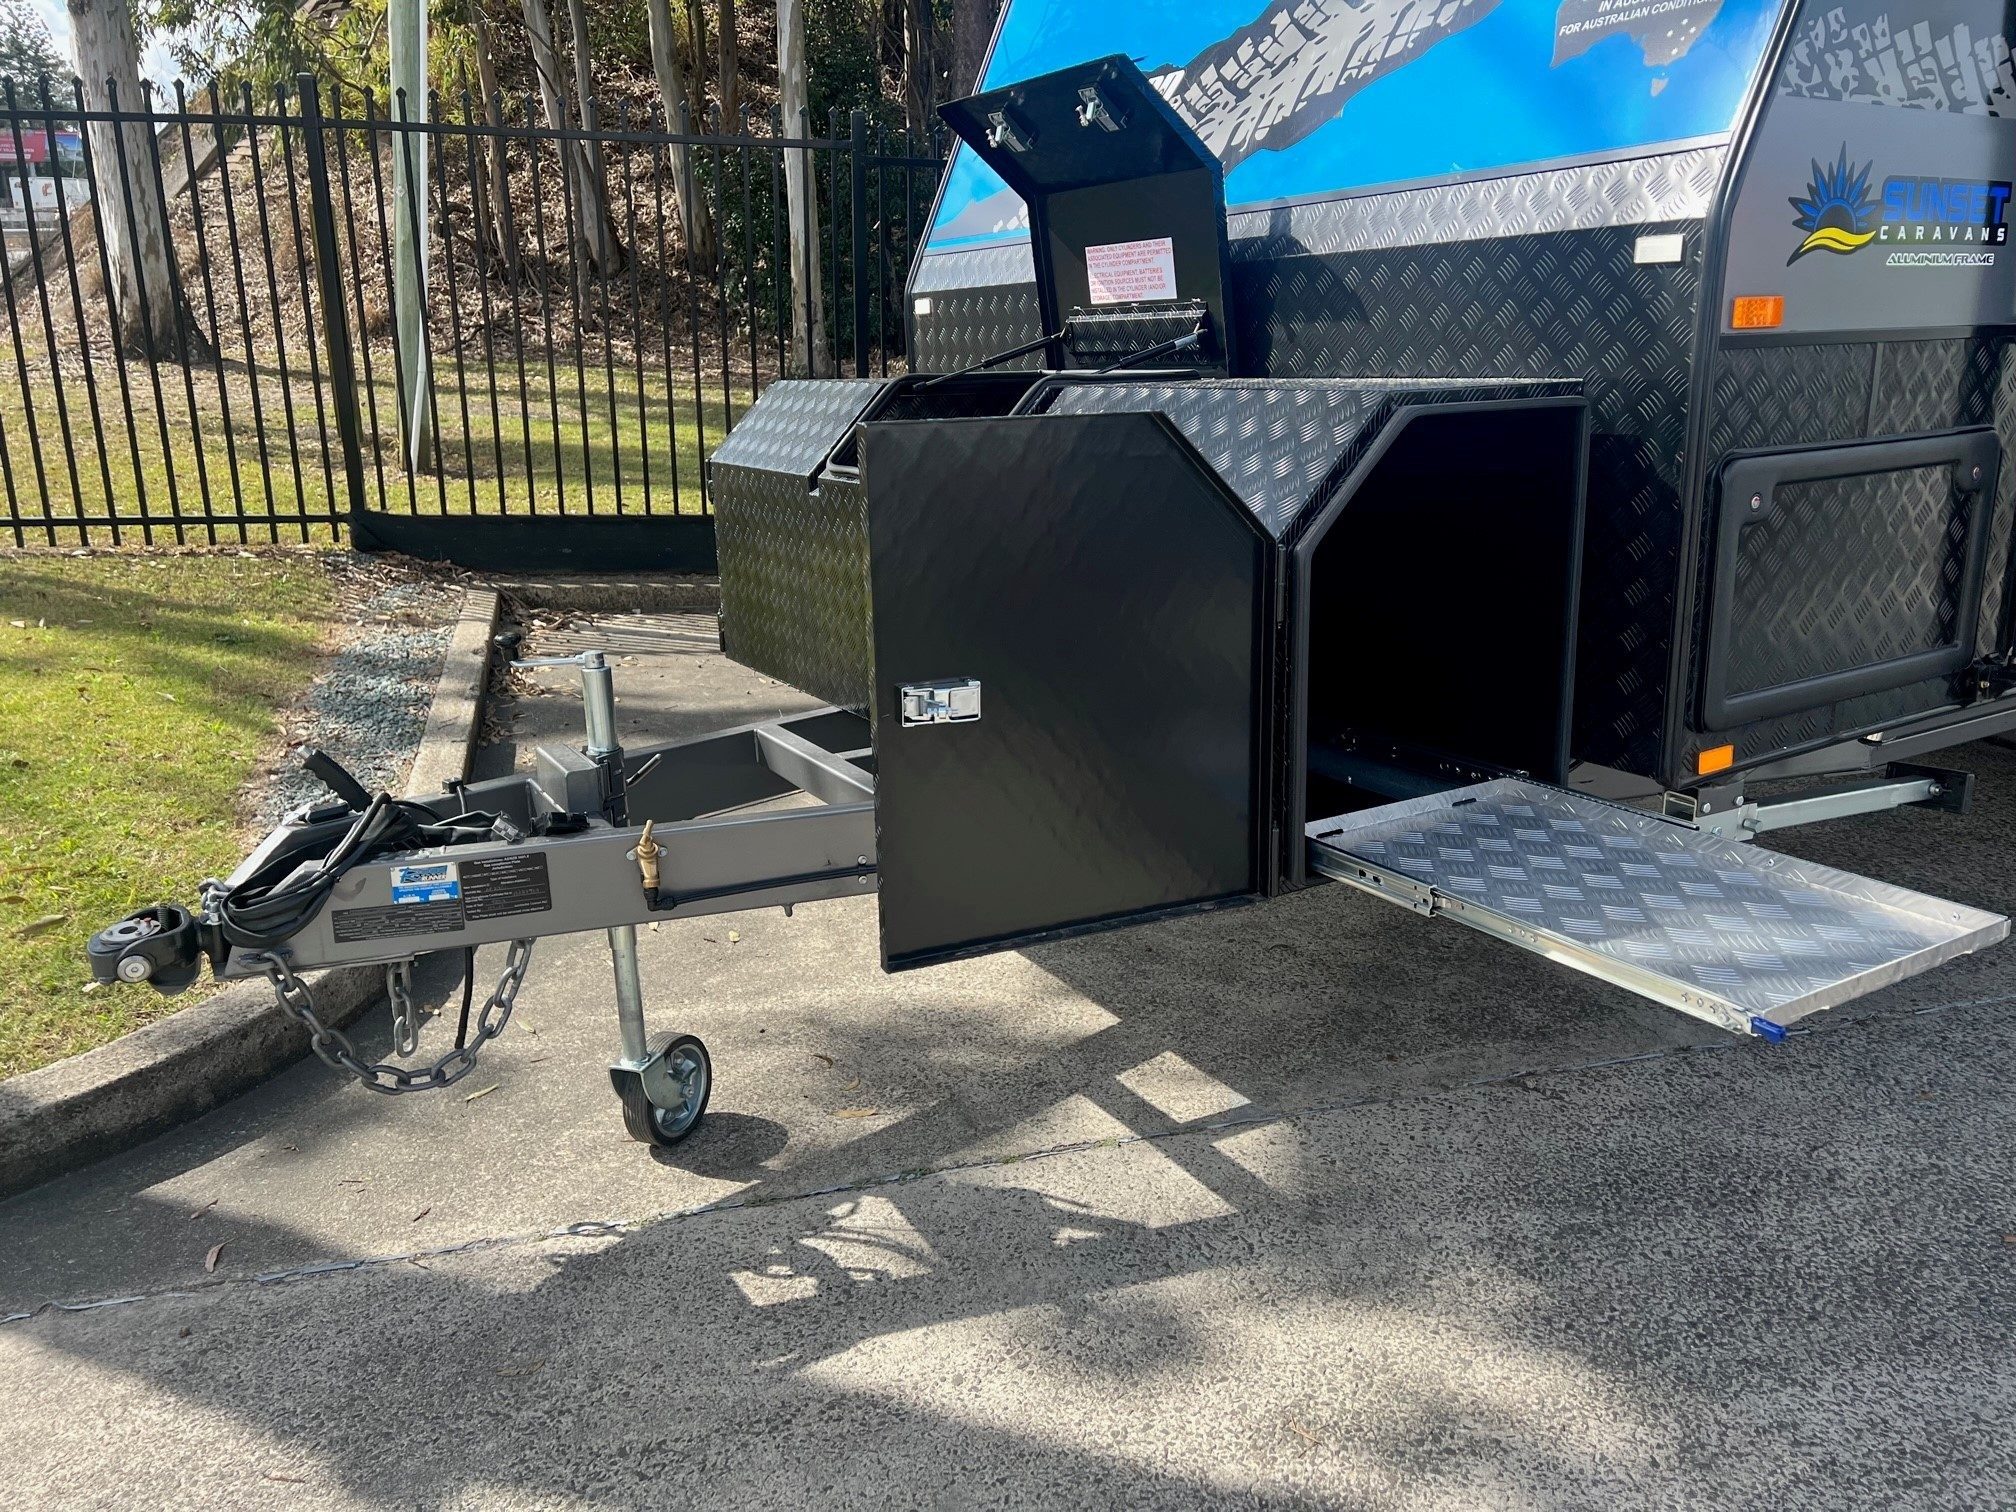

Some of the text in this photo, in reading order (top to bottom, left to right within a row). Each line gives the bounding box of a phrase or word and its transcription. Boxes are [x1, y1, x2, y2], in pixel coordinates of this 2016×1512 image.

[1598, 0, 1612, 13] IN
[1559, 22, 1581, 36] FOR
[1581, 6, 1650, 31] AUSTRALIAN
[1881, 180, 2011, 224] SUNSET
[1880, 225, 2006, 241] CARAVANS
[1113, 250, 1137, 259] EQUIPMENT
[1147, 247, 1172, 256] PERMITTED
[1118, 243, 1142, 251] CYLINDERS
[1886, 253, 1995, 265] ALUMINIUM FRAME
[1114, 276, 1134, 284] SOURCES
